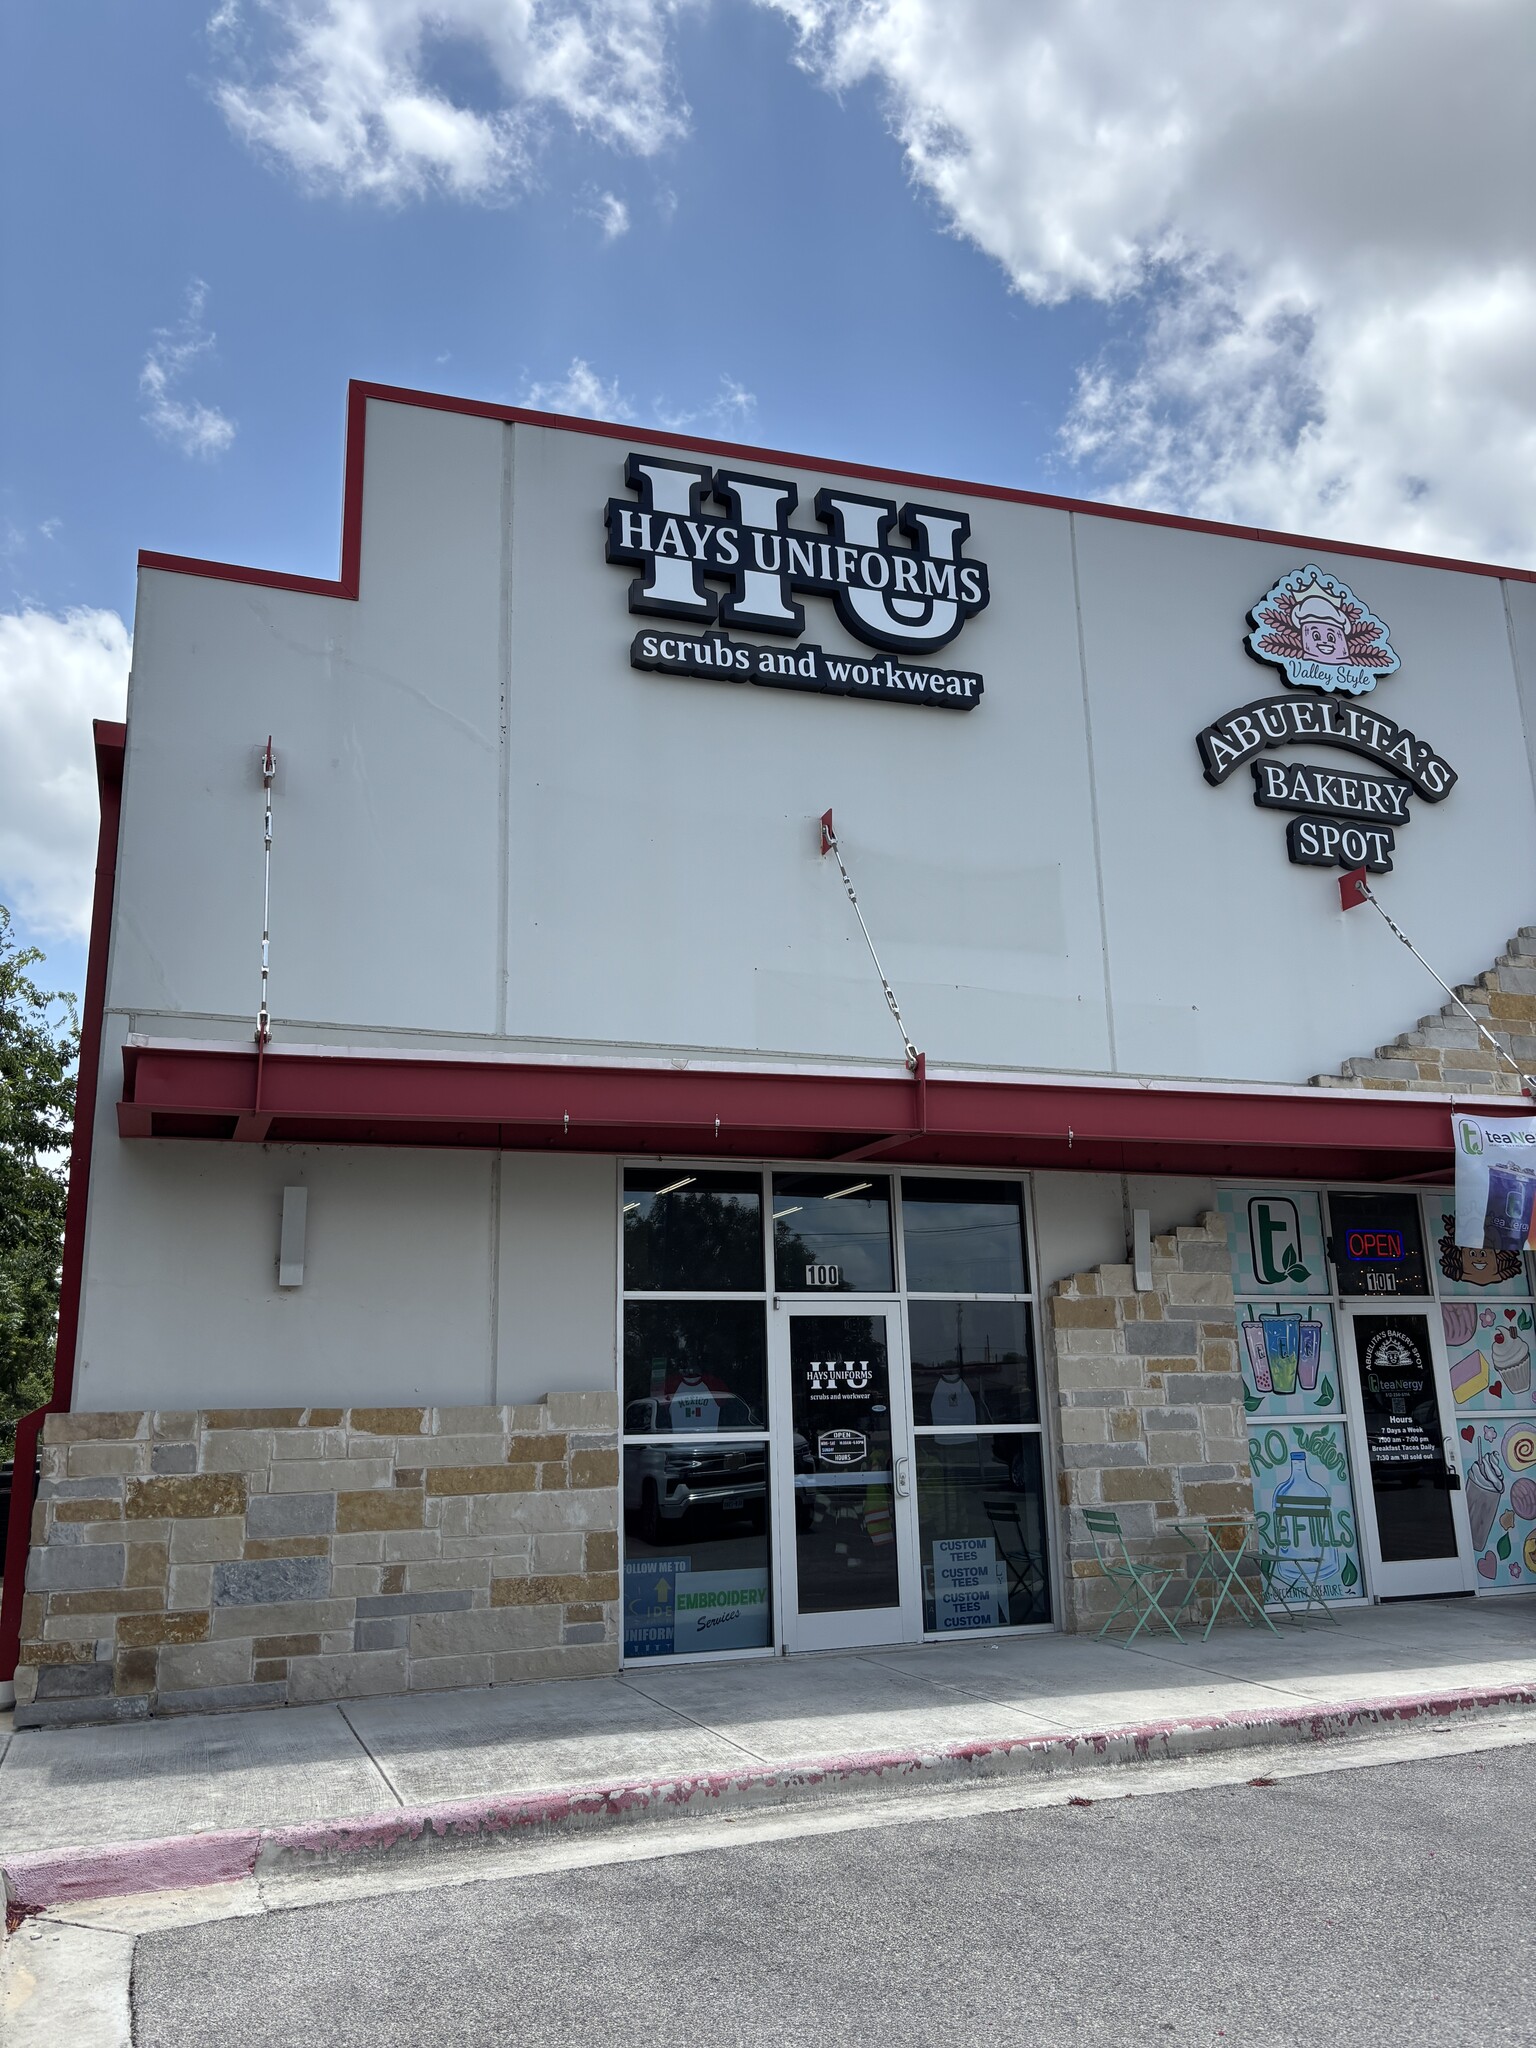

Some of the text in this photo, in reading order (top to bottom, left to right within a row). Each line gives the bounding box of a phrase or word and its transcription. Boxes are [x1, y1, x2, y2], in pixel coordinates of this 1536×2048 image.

[619, 509, 982, 604] HAYS UNIFORMS
[642, 635, 977, 697] scrubs and workwear
[1289, 660, 1371, 688] Valley Style
[1207, 702, 1450, 793] ABUELITA'S
[1263, 766, 1408, 816] BAKERY
[1300, 823, 1389, 864] SPOT
[1350, 1233, 1402, 1257] OPEN
[808, 1265, 838, 1285] 100
[1369, 1274, 1396, 1290] 101
[1365, 1330, 1424, 1371] ABUELITA'S BAKERY SPOT
[807, 1370, 873, 1380] HAYS UNIFORMS
[678, 1398, 709, 1408] MEXICO
[1248, 1429, 1288, 1477] RO
[940, 1540, 987, 1551] CUSTOM
[950, 1551, 978, 1561] TEES
[658, 1562, 673, 1573] ME
[673, 1561, 686, 1572] TO
[941, 1566, 988, 1578] CUSTOM
[952, 1577, 979, 1588] TEES
[676, 1588, 766, 1611] EMBROIDERY
[943, 1591, 990, 1603] CUSTOM
[953, 1602, 980, 1613] TEES
[696, 1609, 741, 1632] Services
[944, 1614, 991, 1627] CUSTOM
